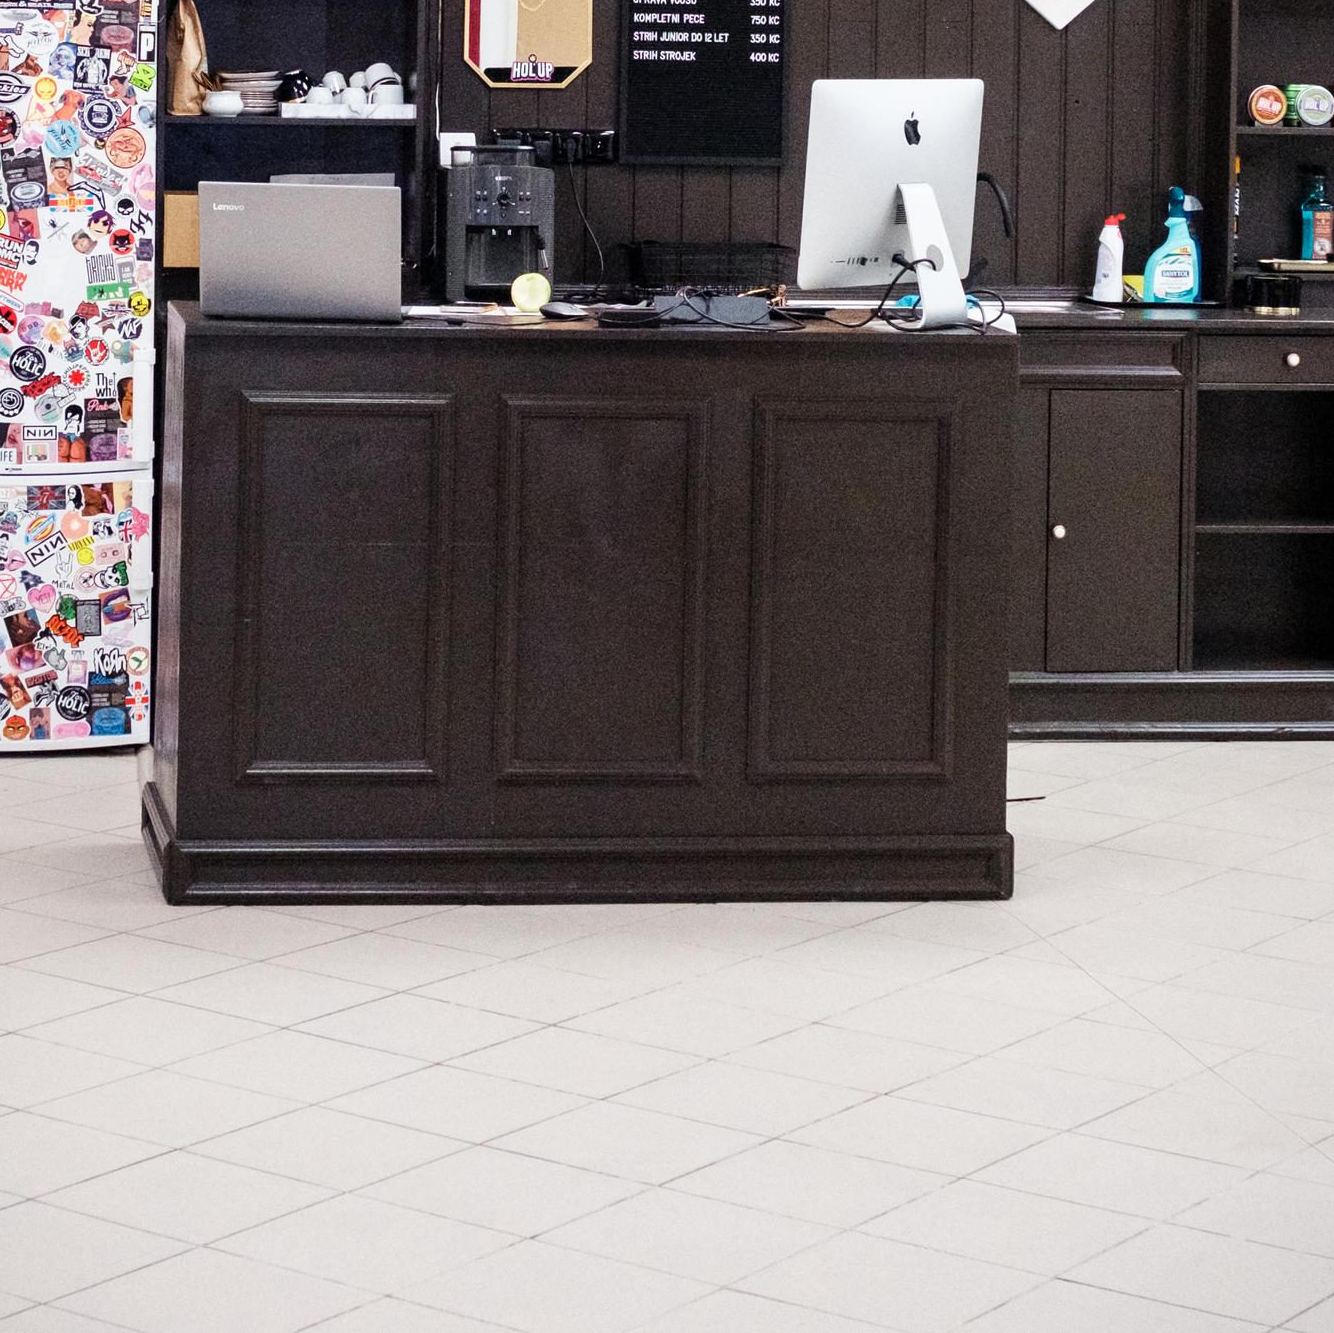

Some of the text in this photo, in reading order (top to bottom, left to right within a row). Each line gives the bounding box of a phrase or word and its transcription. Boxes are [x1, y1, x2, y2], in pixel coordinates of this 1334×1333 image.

[633, 12, 780, 25] KOMPLETNI PECE 750 KC
[633, 32, 780, 44] STRIH JUNIOR DO 12 LET 350 KC
[633, 50, 780, 62] STRIH STROJEK 400 KC
[212, 202, 245, 211] Lenovo
[12, 354, 43, 376] HOLIC
[87, 399, 108, 412] Pink
[57, 694, 89, 715] HOLIC
